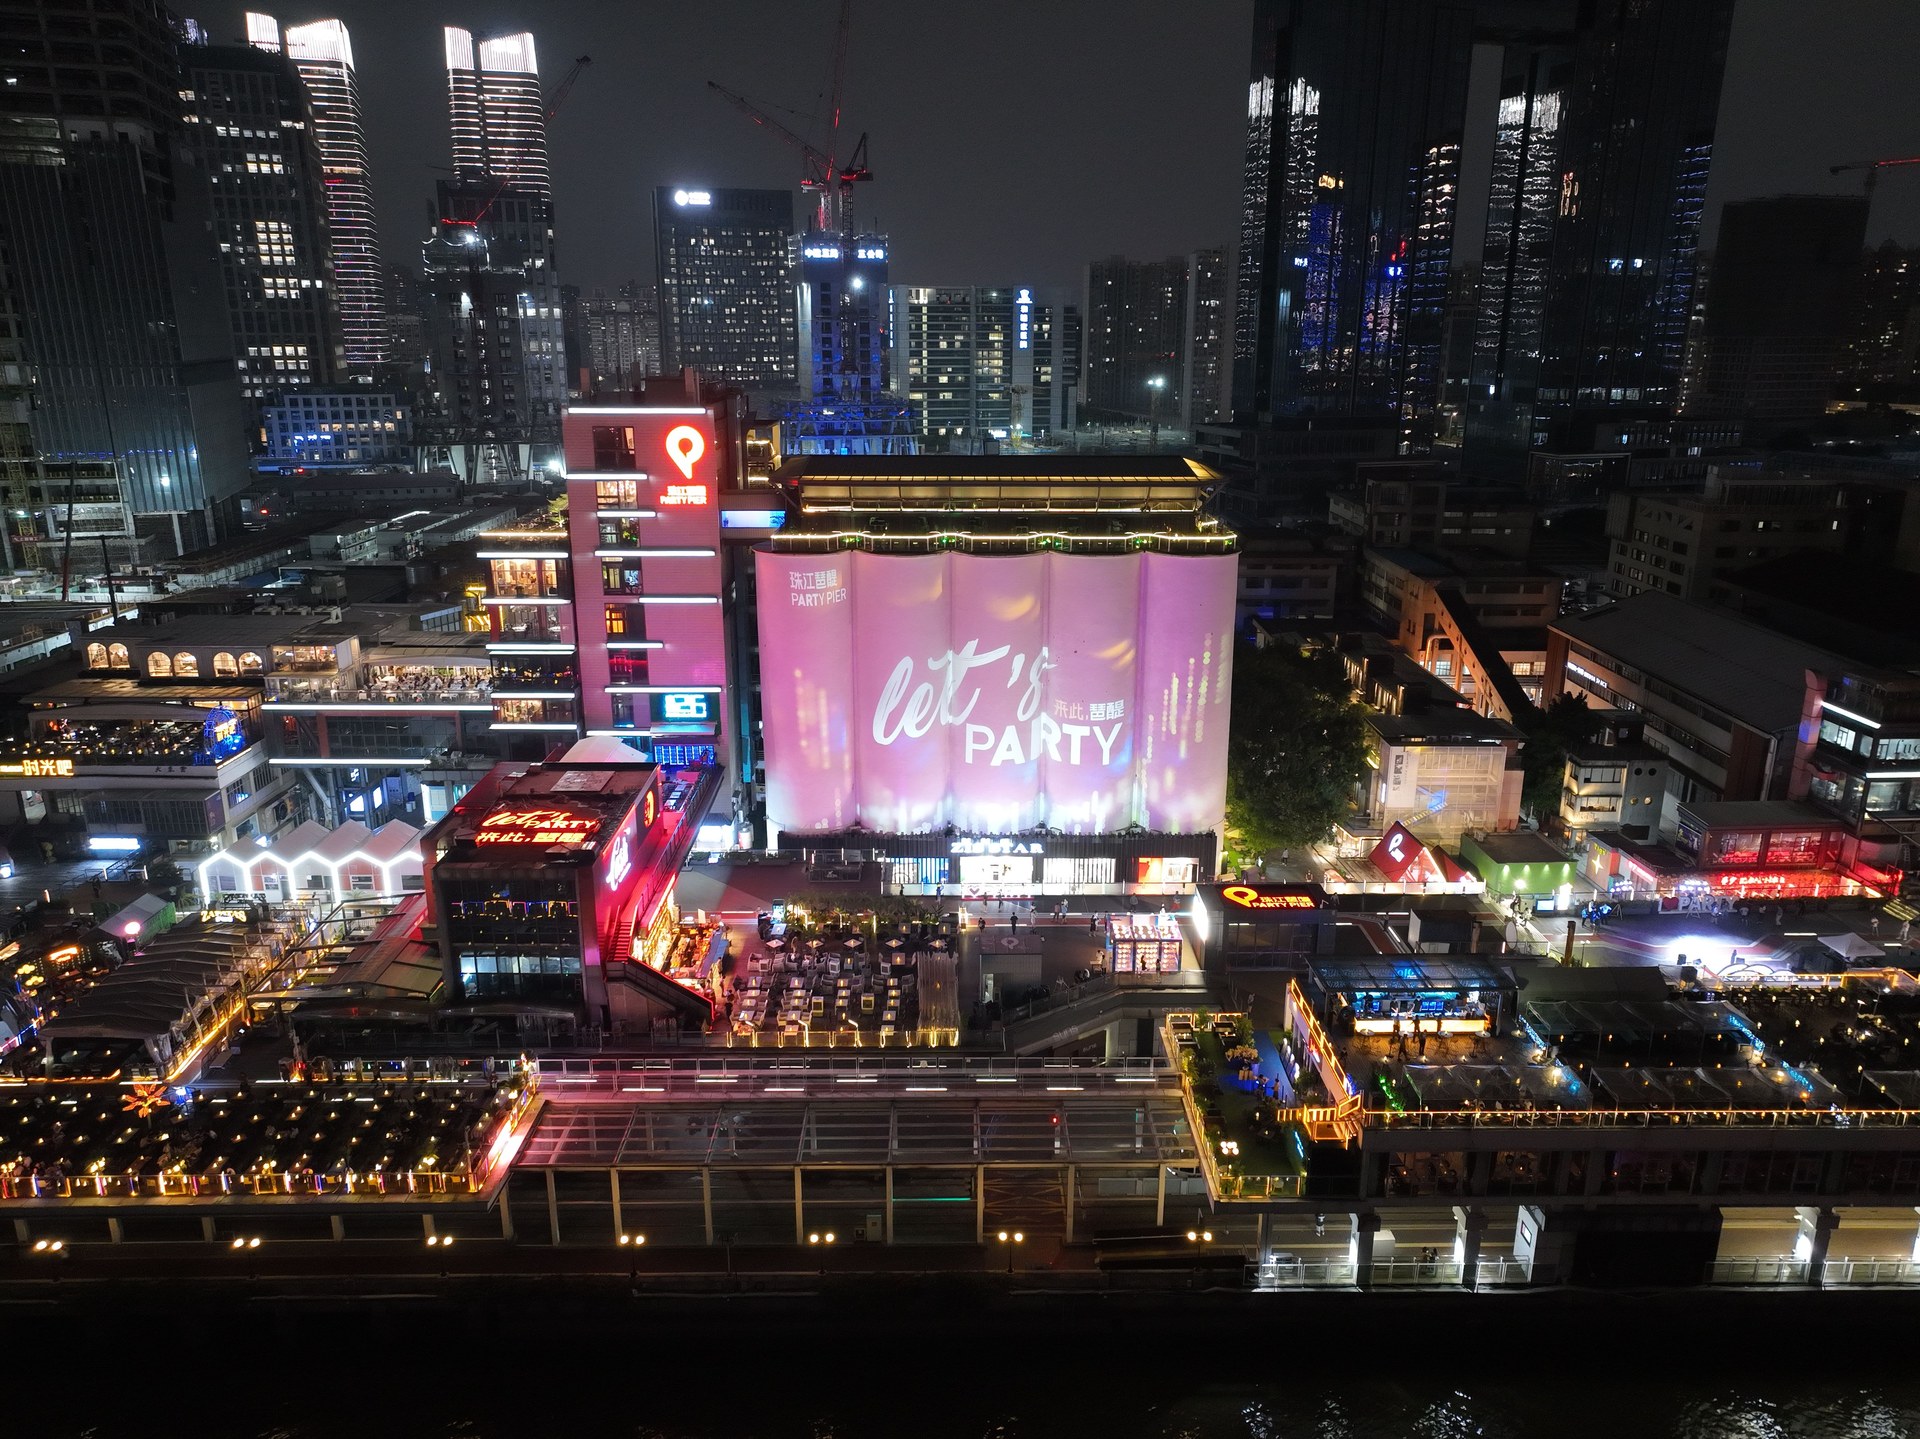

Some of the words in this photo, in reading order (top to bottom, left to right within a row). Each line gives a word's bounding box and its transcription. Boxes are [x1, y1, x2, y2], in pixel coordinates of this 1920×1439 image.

[791, 592, 825, 607] PARTY
[826, 588, 847, 605] PIER
[872, 638, 1058, 746] let's
[965, 712, 1123, 766] PARTY
[23, 760, 74, 776] 时光吧
[524, 820, 596, 829] PARTY
